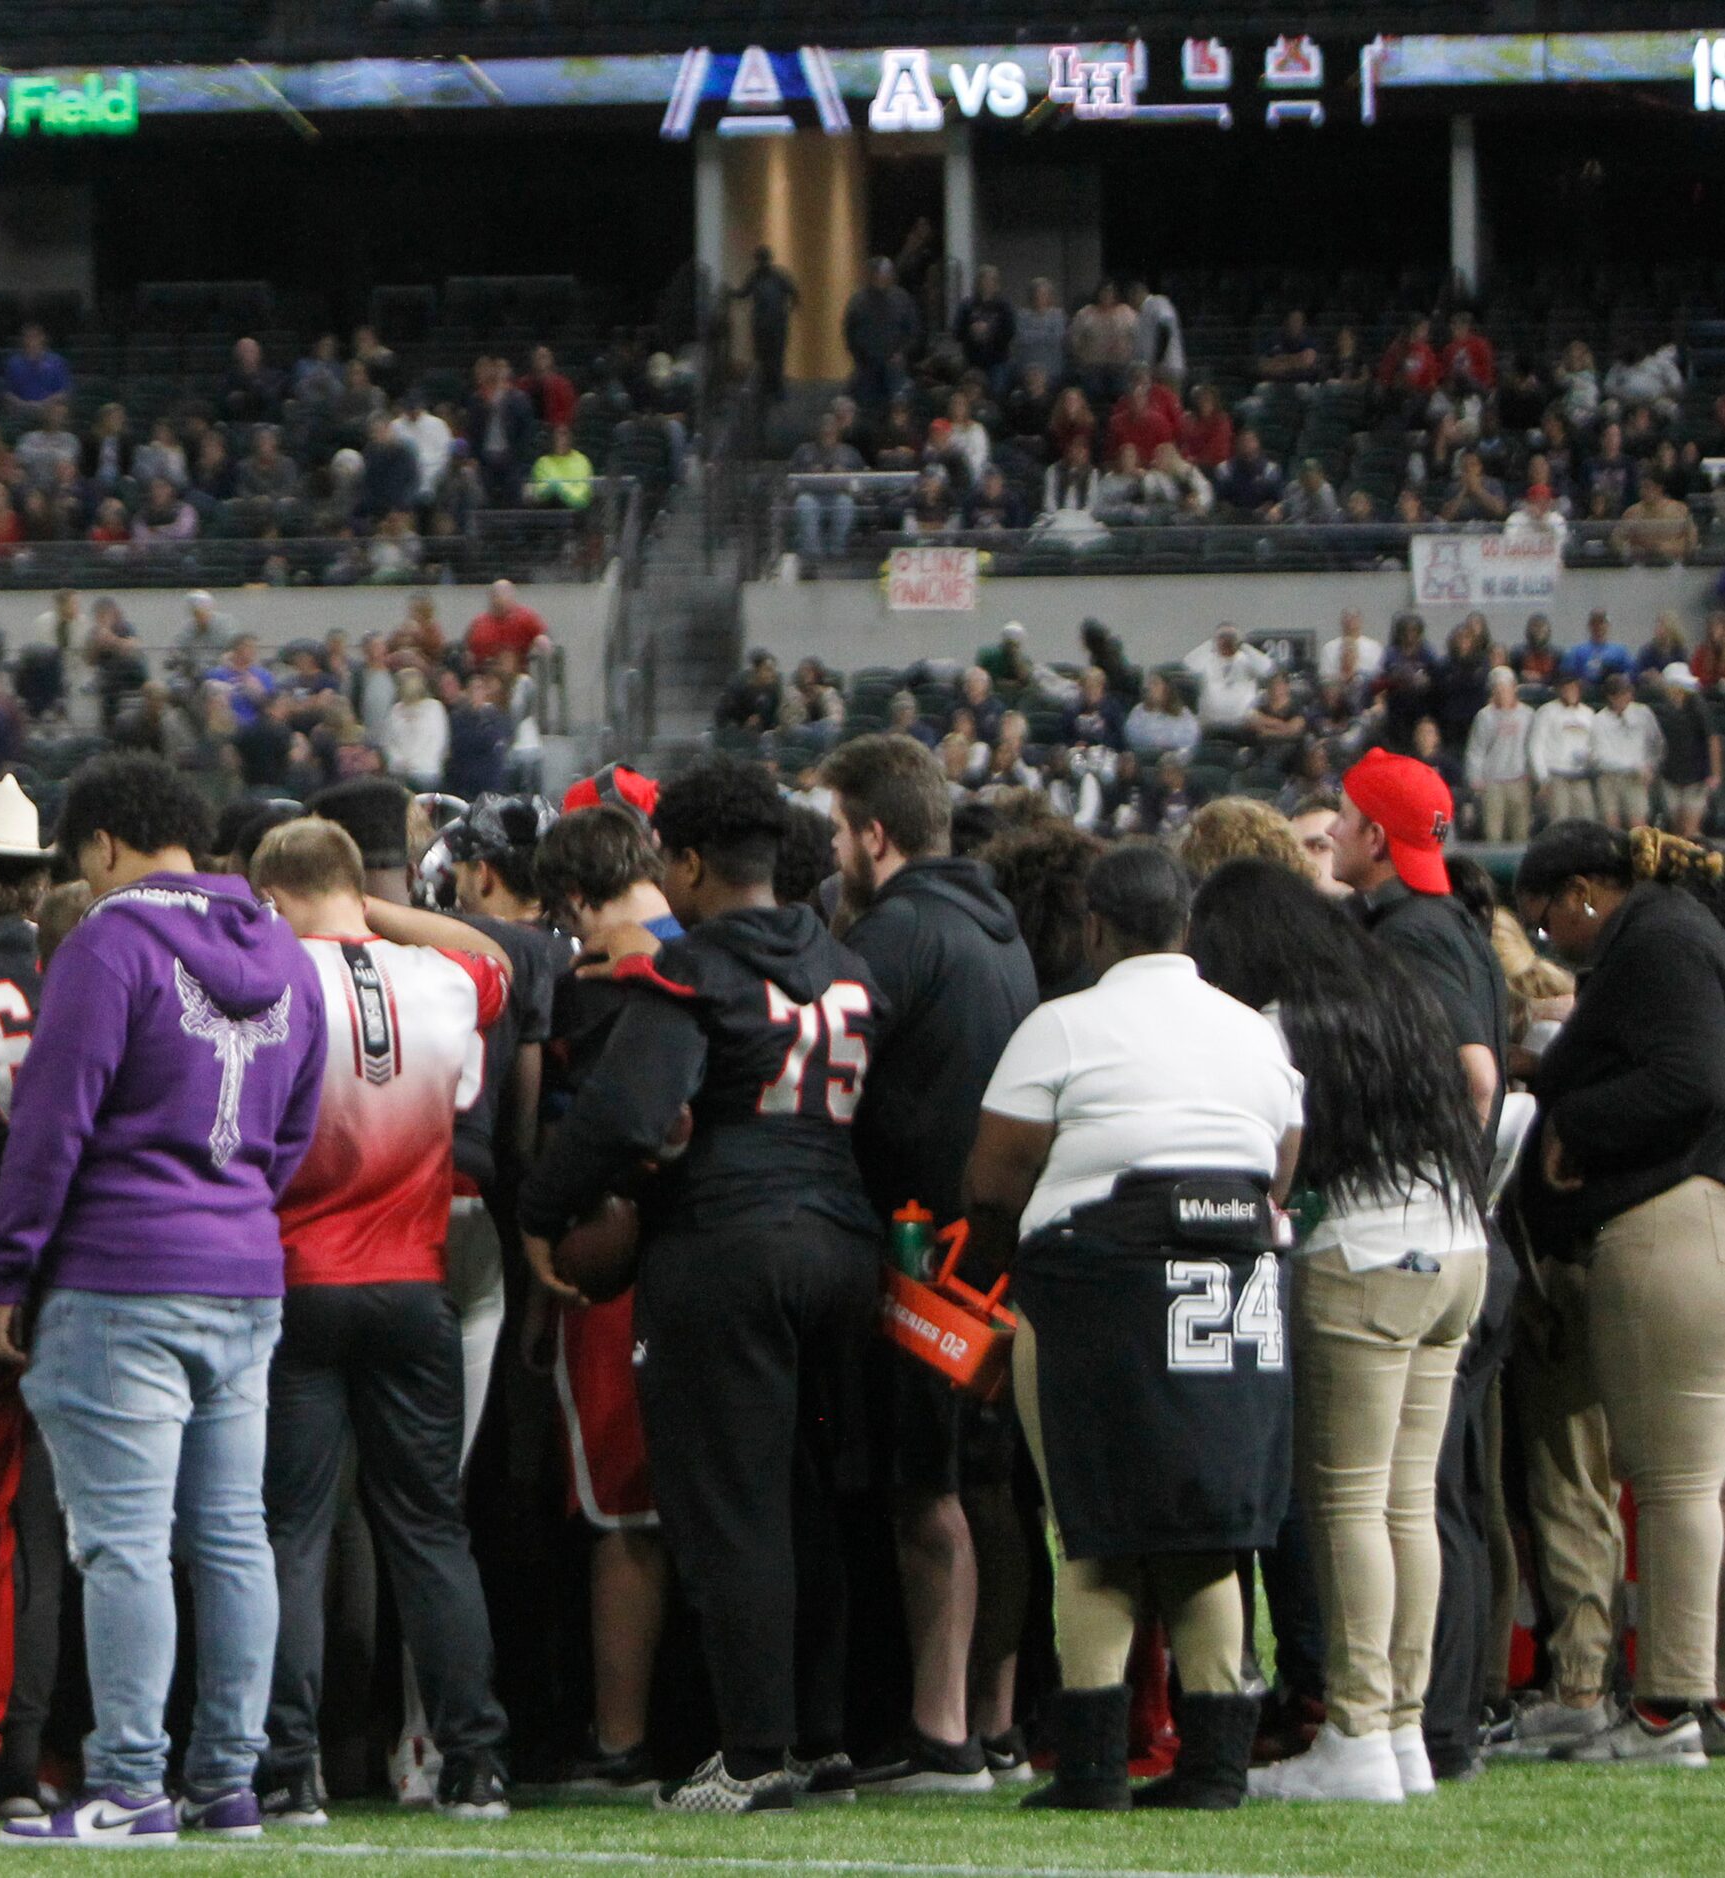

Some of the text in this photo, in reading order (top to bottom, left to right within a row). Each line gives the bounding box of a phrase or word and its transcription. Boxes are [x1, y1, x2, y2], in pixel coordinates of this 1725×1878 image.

[8, 72, 139, 136] Field
[869, 49, 944, 132] A
[757, 980, 872, 1124] 75
[1194, 1198, 1256, 1221] Mueller
[939, 1331, 969, 1361] 02
[1165, 1251, 1284, 1371] 24
